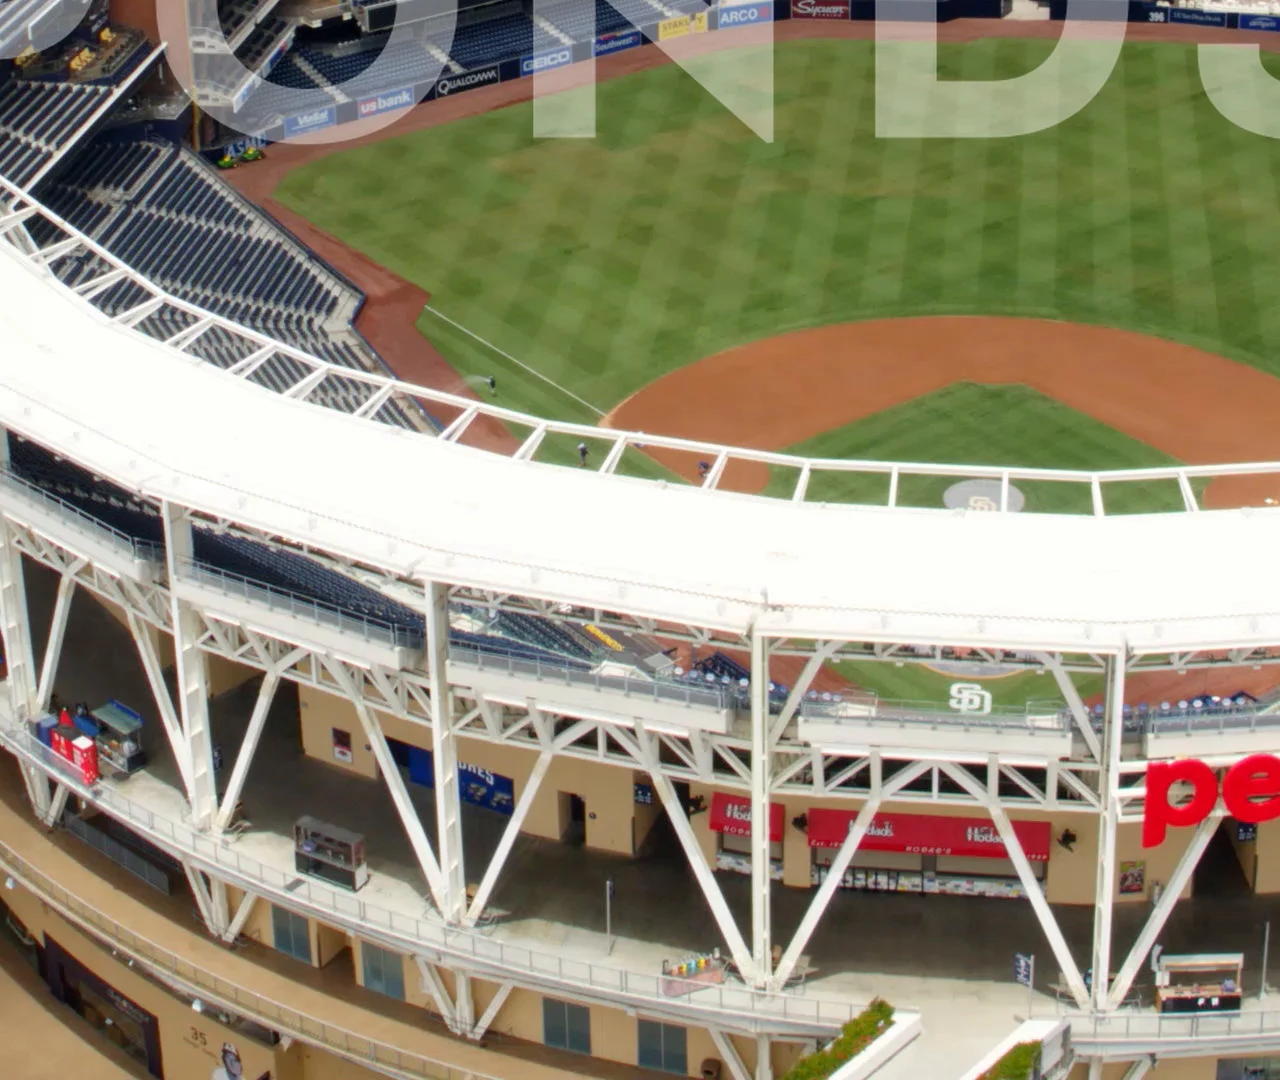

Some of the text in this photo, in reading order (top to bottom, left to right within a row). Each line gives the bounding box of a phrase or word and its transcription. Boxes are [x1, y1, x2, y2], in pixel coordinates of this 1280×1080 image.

[720, 8, 758, 23] ARCO
[797, 0, 845, 17] Sycuan
[1149, 11, 1165, 22] 396
[595, 36, 633, 52] Southwest
[523, 51, 570, 72] GEICO
[438, 70, 496, 95] QUALCOMM
[191, 1026, 208, 1047] 35
